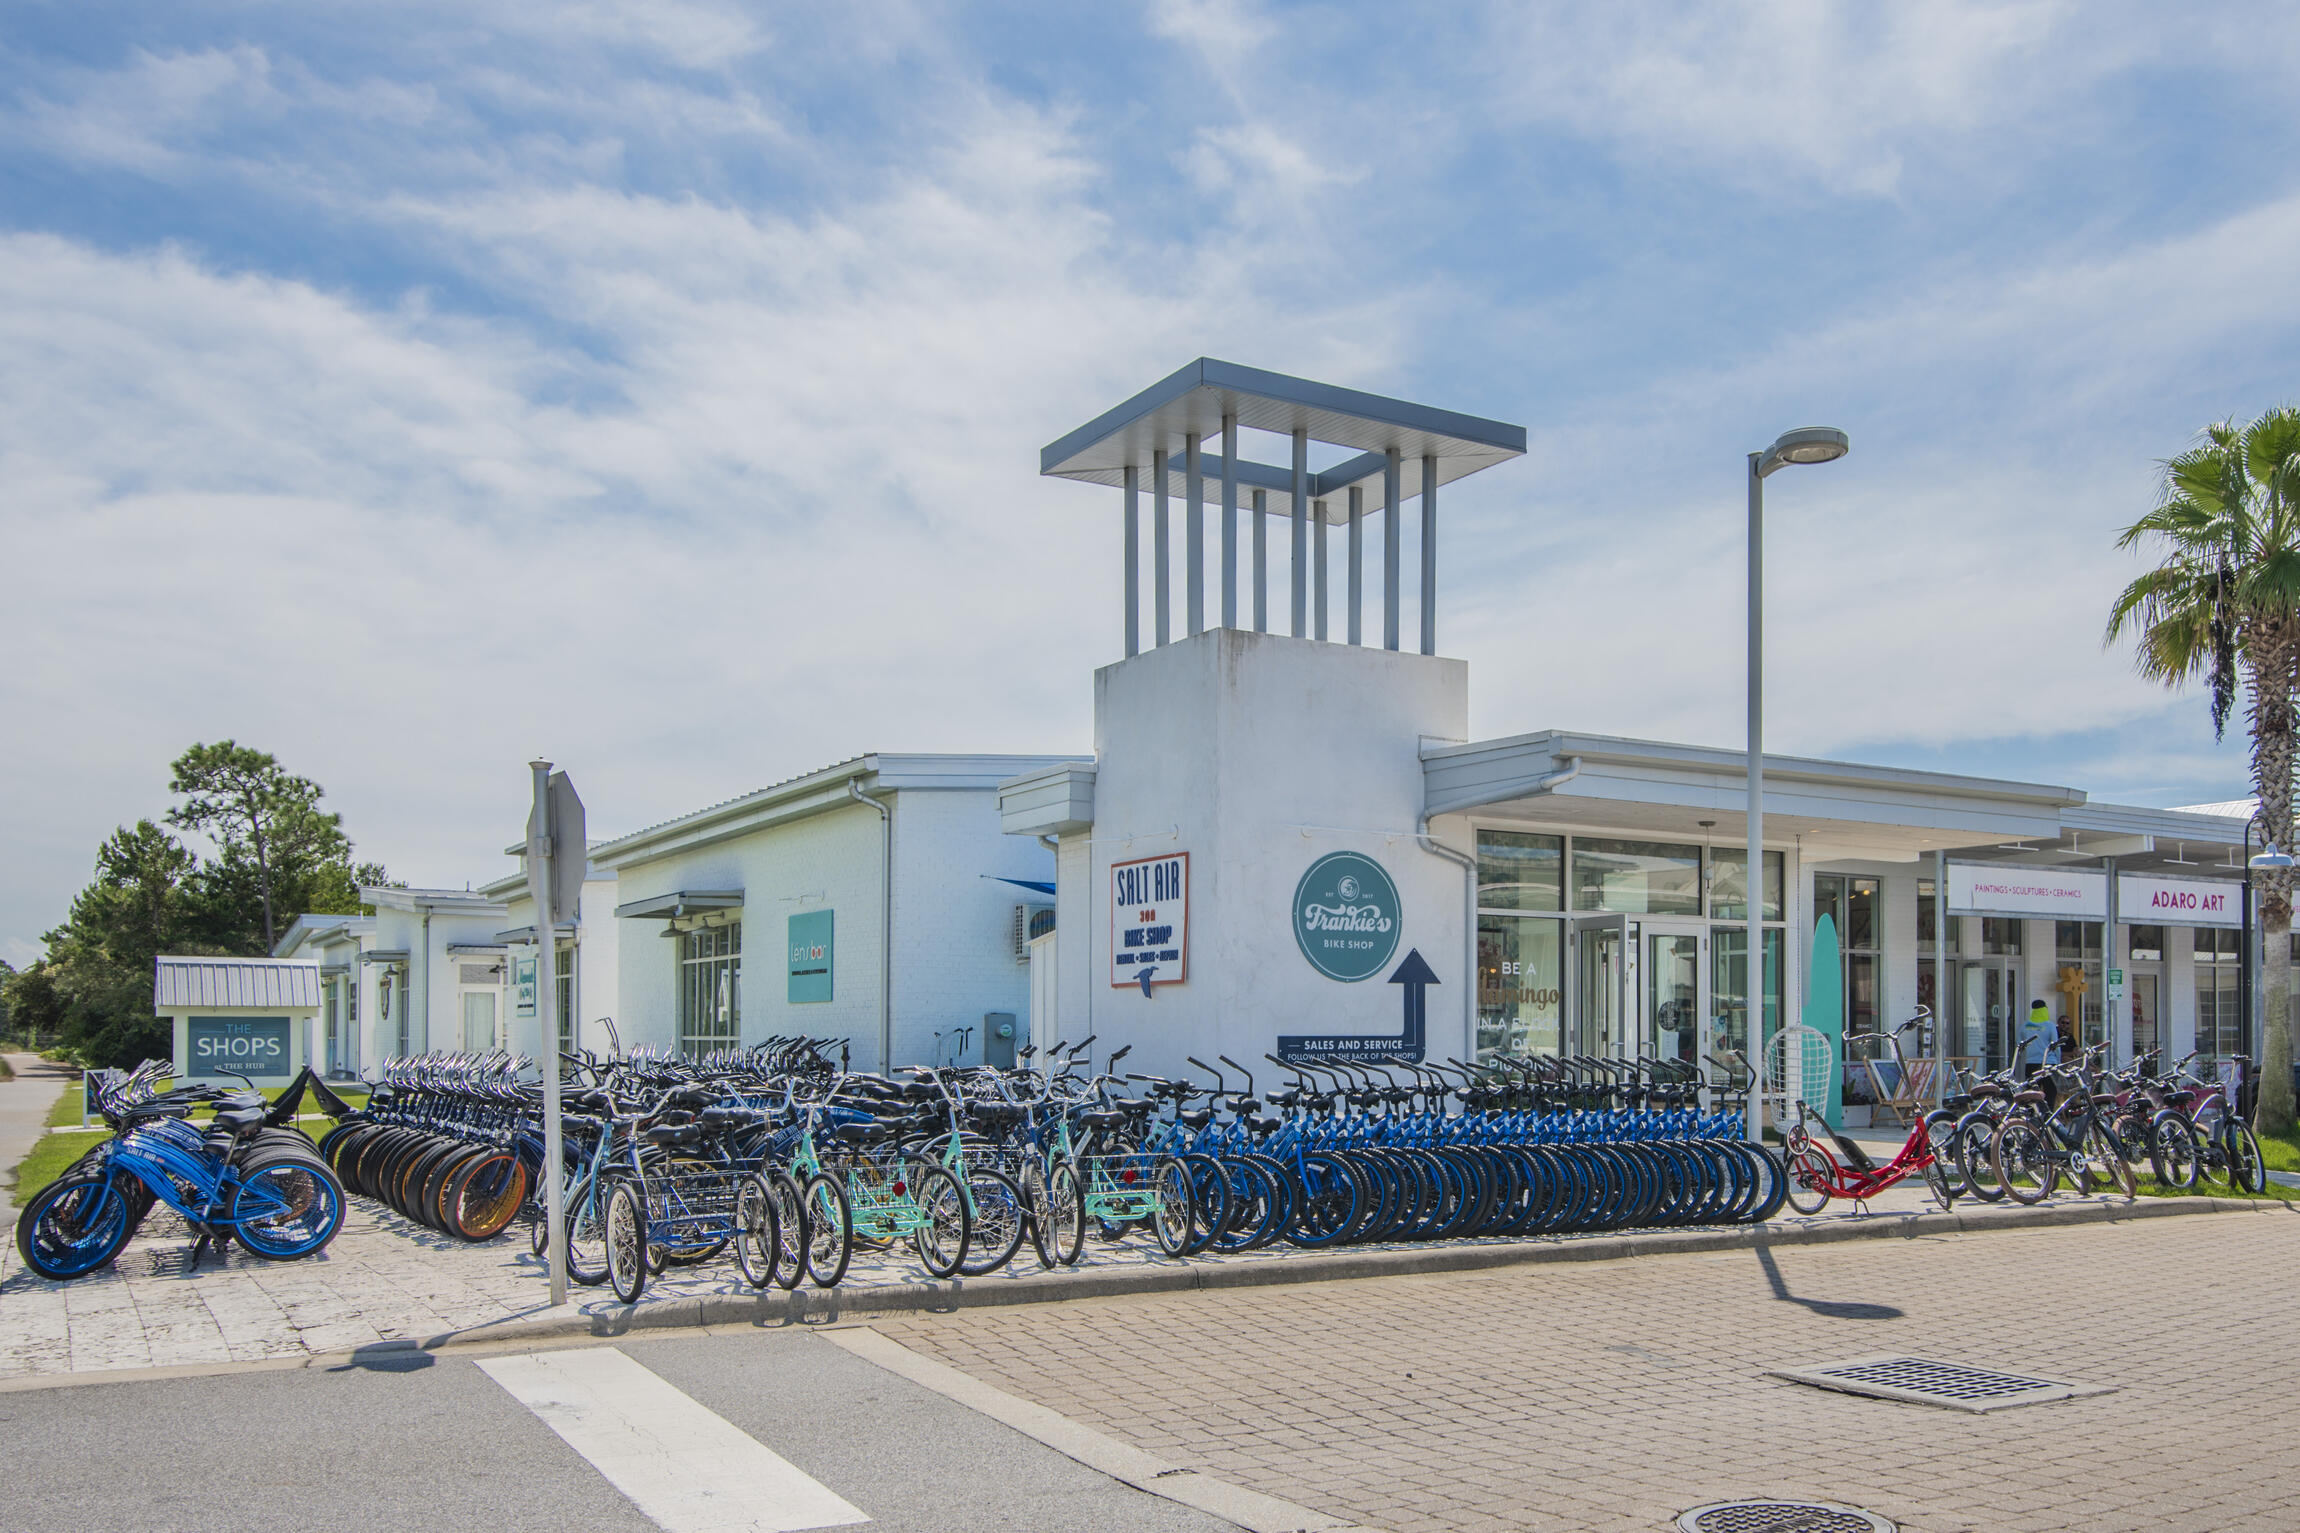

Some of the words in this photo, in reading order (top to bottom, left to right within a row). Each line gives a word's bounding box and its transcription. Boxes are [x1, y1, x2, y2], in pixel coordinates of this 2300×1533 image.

[1117, 865, 1148, 906] SALT
[1155, 861, 1179, 902] AIR
[1975, 884, 2008, 894] PAINTINGS
[2012, 886, 2048, 896] SCULPTURES
[2053, 888, 2082, 898] CERAMICS
[2152, 890, 2197, 909] ADARO
[2202, 893, 2224, 911] ART
[1124, 928, 1144, 947] BIKE
[1146, 925, 1172, 945] SHOP
[1324, 939, 1345, 949] BIKE
[1348, 940, 1374, 950] SHOP
[1502, 962, 1521, 975] BE
[1526, 963, 1536, 975] A
[225, 1023, 252, 1034] THE
[1477, 1017, 1491, 1031] IN
[1498, 1017, 1507, 1031] A
[197, 1037, 280, 1056] SHOPS
[1304, 1040, 1335, 1050] SALES
[1337, 1040, 1360, 1050] AND
[1364, 1040, 1403, 1050] SERVICE
[1287, 1053, 1315, 1061] FOLLOW
[1317, 1053, 1326, 1061] US
[1351, 1052, 1369, 1060] BACK
[1488, 1059, 1555, 1071] PIGONS
[143, 1151, 156, 1162] AIR
